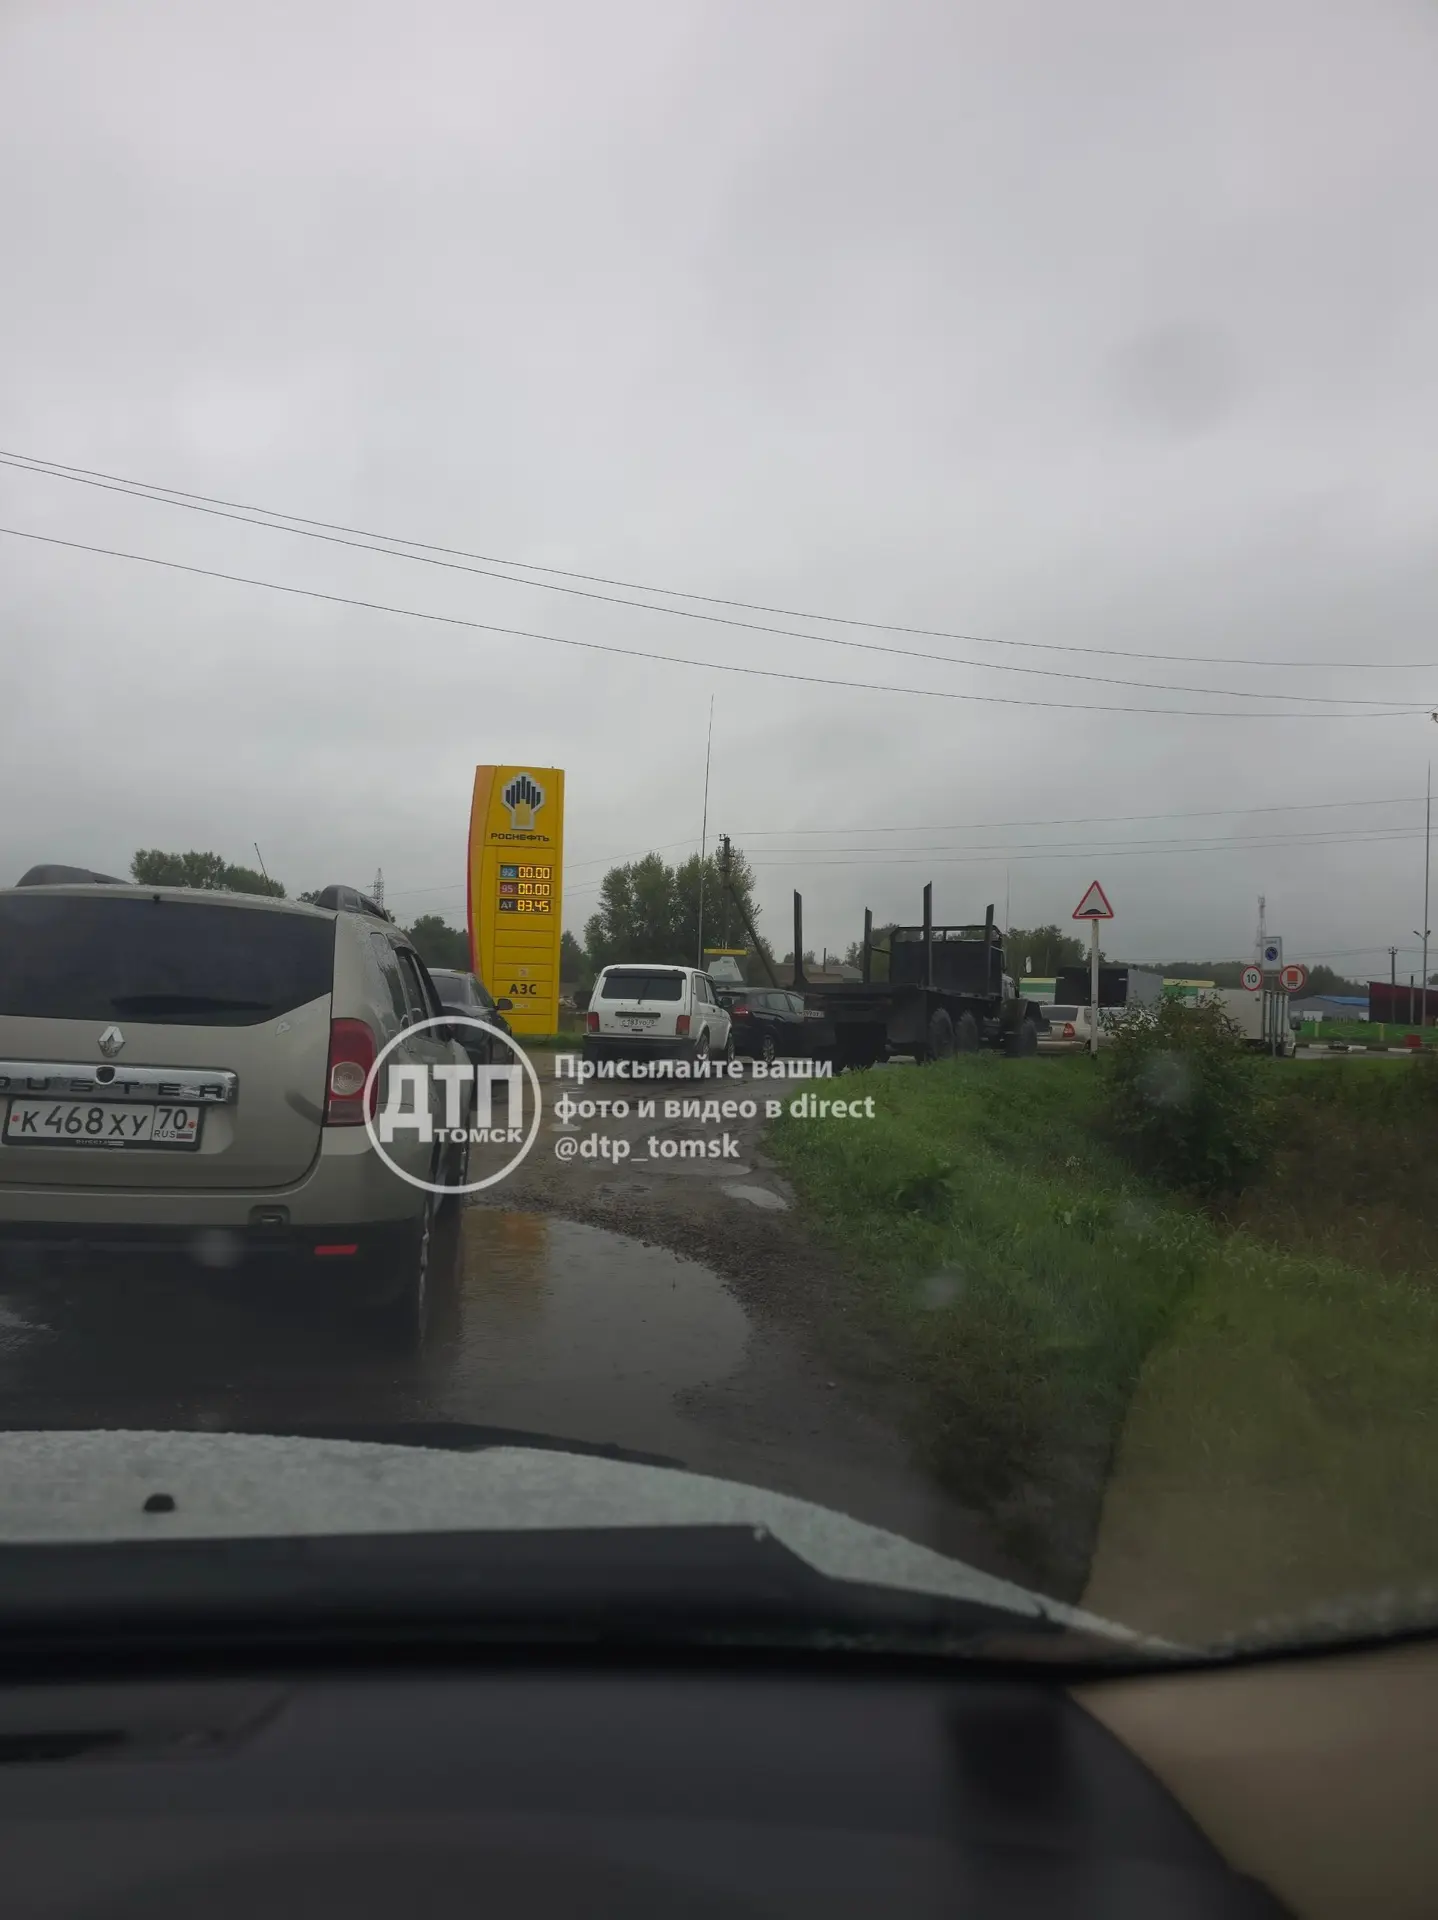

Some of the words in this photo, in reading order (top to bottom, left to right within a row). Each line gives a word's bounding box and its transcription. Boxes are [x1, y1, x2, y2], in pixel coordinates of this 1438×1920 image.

[491, 833, 550, 842] РОСНЕФТЬ
[502, 868, 514, 877] 92
[518, 866, 550, 879] 00.00
[502, 884, 514, 893] 95
[518, 883, 550, 895] 00.00
[517, 900, 549, 912] 83.45
[1246, 974, 1257, 983] 10
[509, 984, 537, 995] АЗС
[159, 1109, 188, 1129] 70
[154, 1129, 176, 1139] RUS
